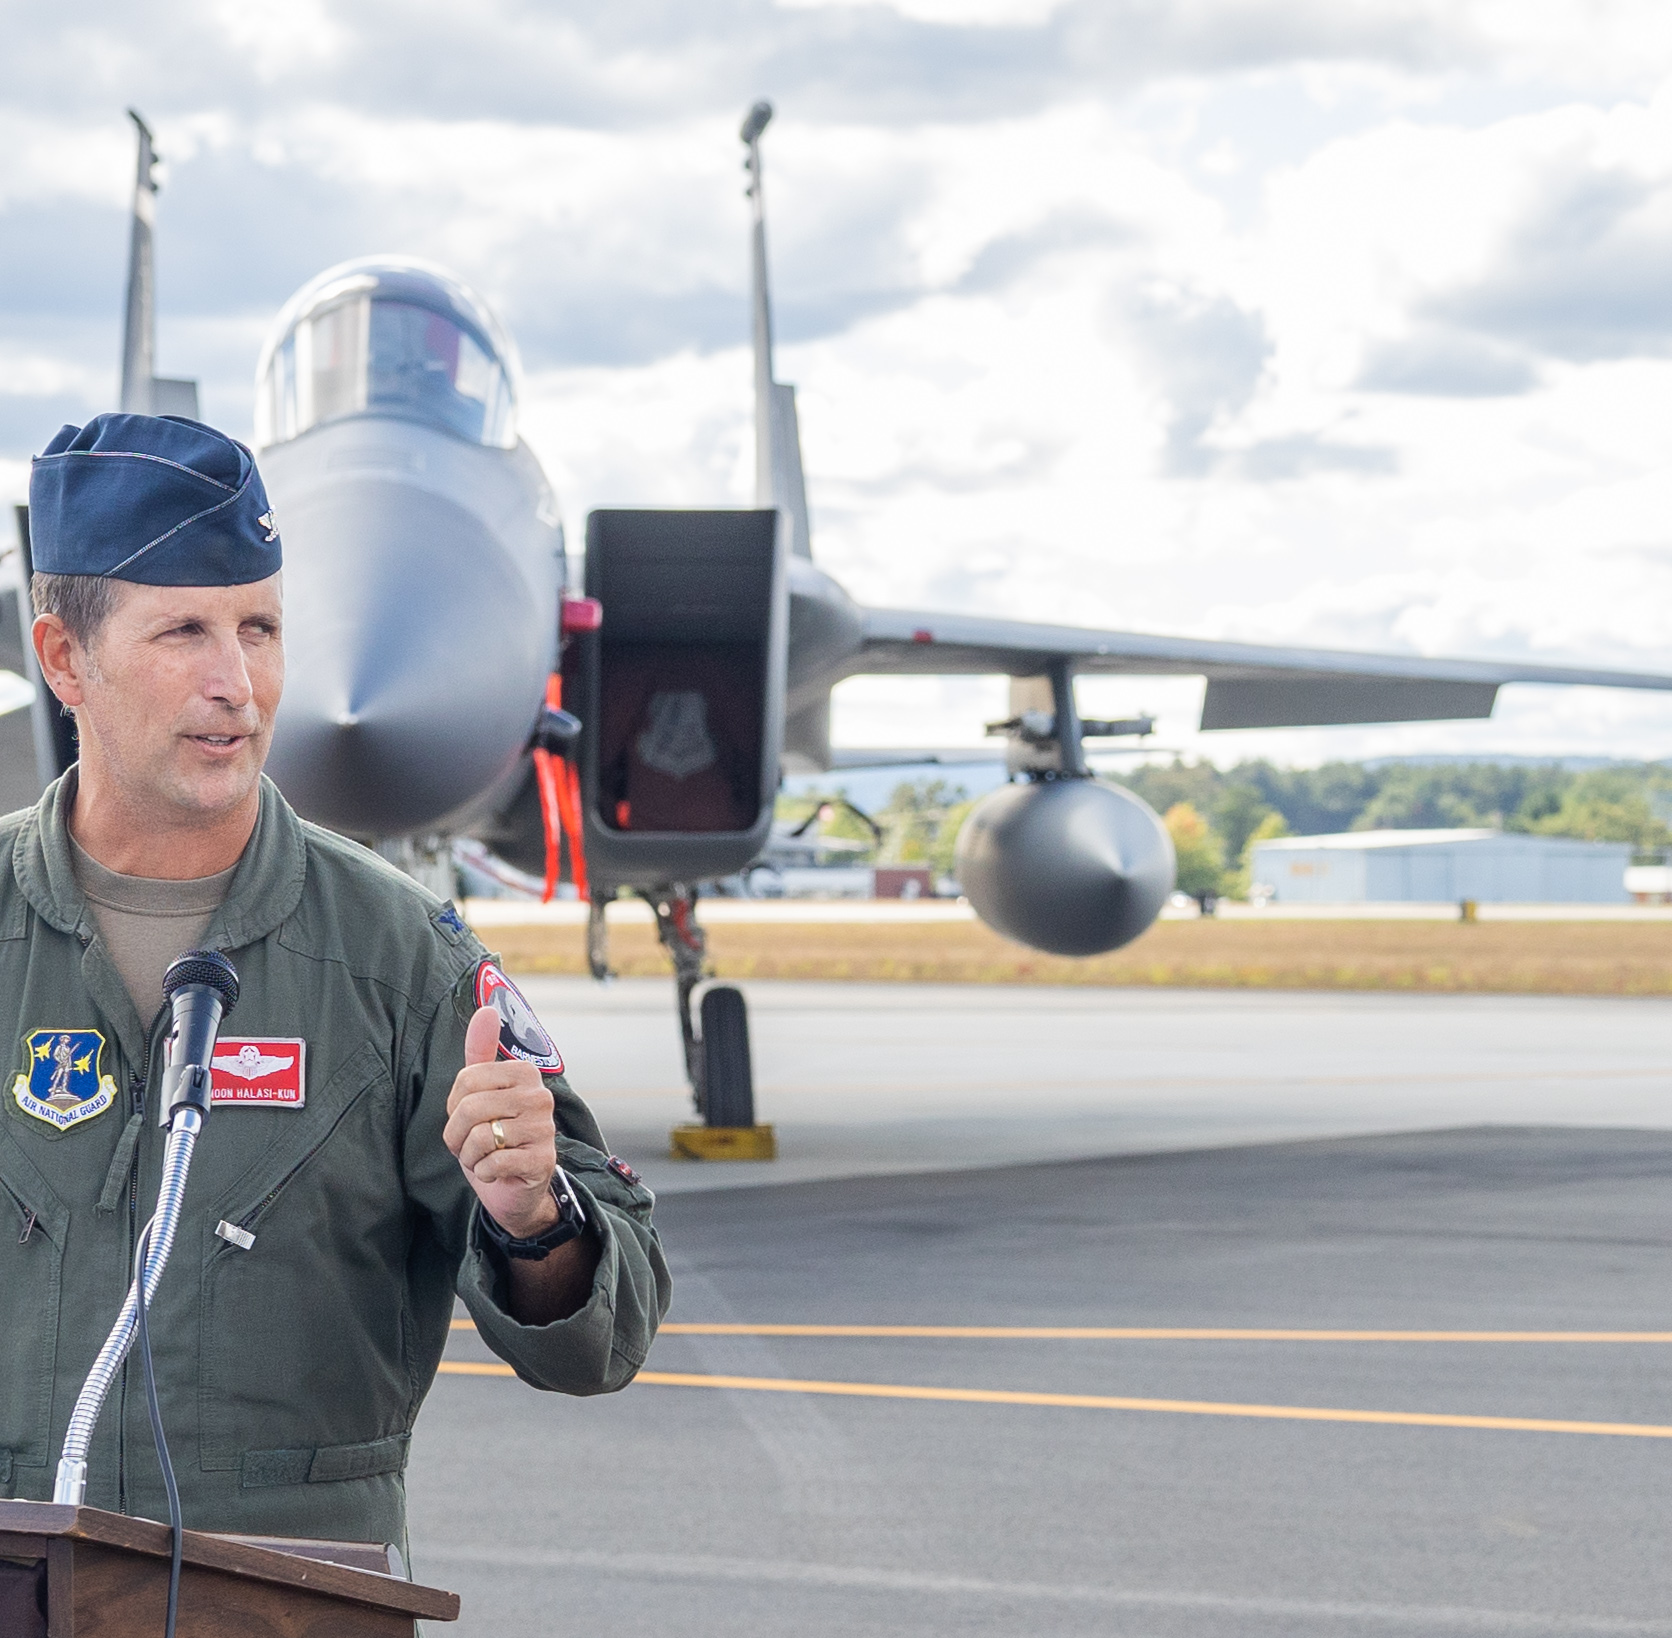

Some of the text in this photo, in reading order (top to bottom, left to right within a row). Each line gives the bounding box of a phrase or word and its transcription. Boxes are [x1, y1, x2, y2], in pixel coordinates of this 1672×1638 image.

[236, 1087, 296, 1099] HALASI-KUN
[22, 1094, 108, 1126] AIR NATIONAL GUARD
